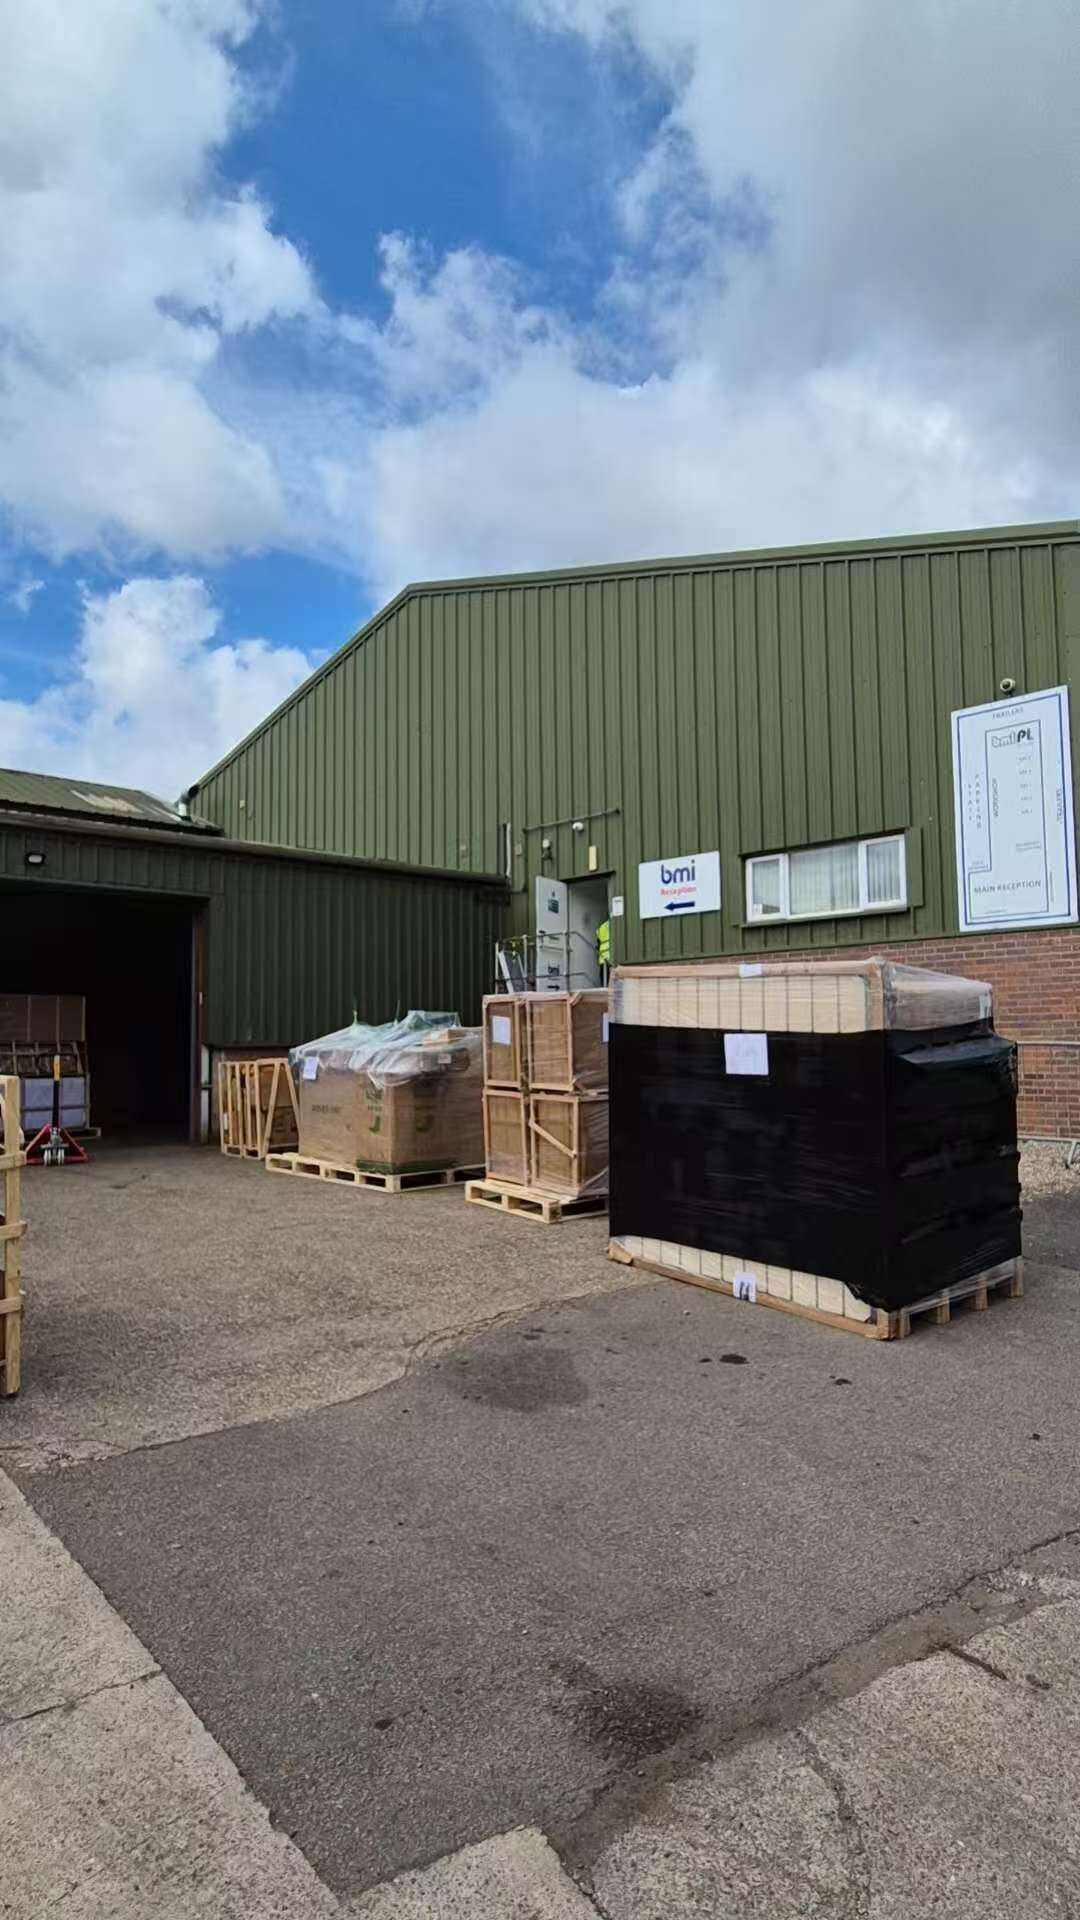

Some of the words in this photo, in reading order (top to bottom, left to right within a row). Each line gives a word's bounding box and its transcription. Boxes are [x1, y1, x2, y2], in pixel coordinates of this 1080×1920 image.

[992, 706, 1024, 719] TRAILERS
[661, 859, 695, 884] bmi
[974, 885, 995, 894] MAIN
[997, 879, 1041, 892] RECEPTION
